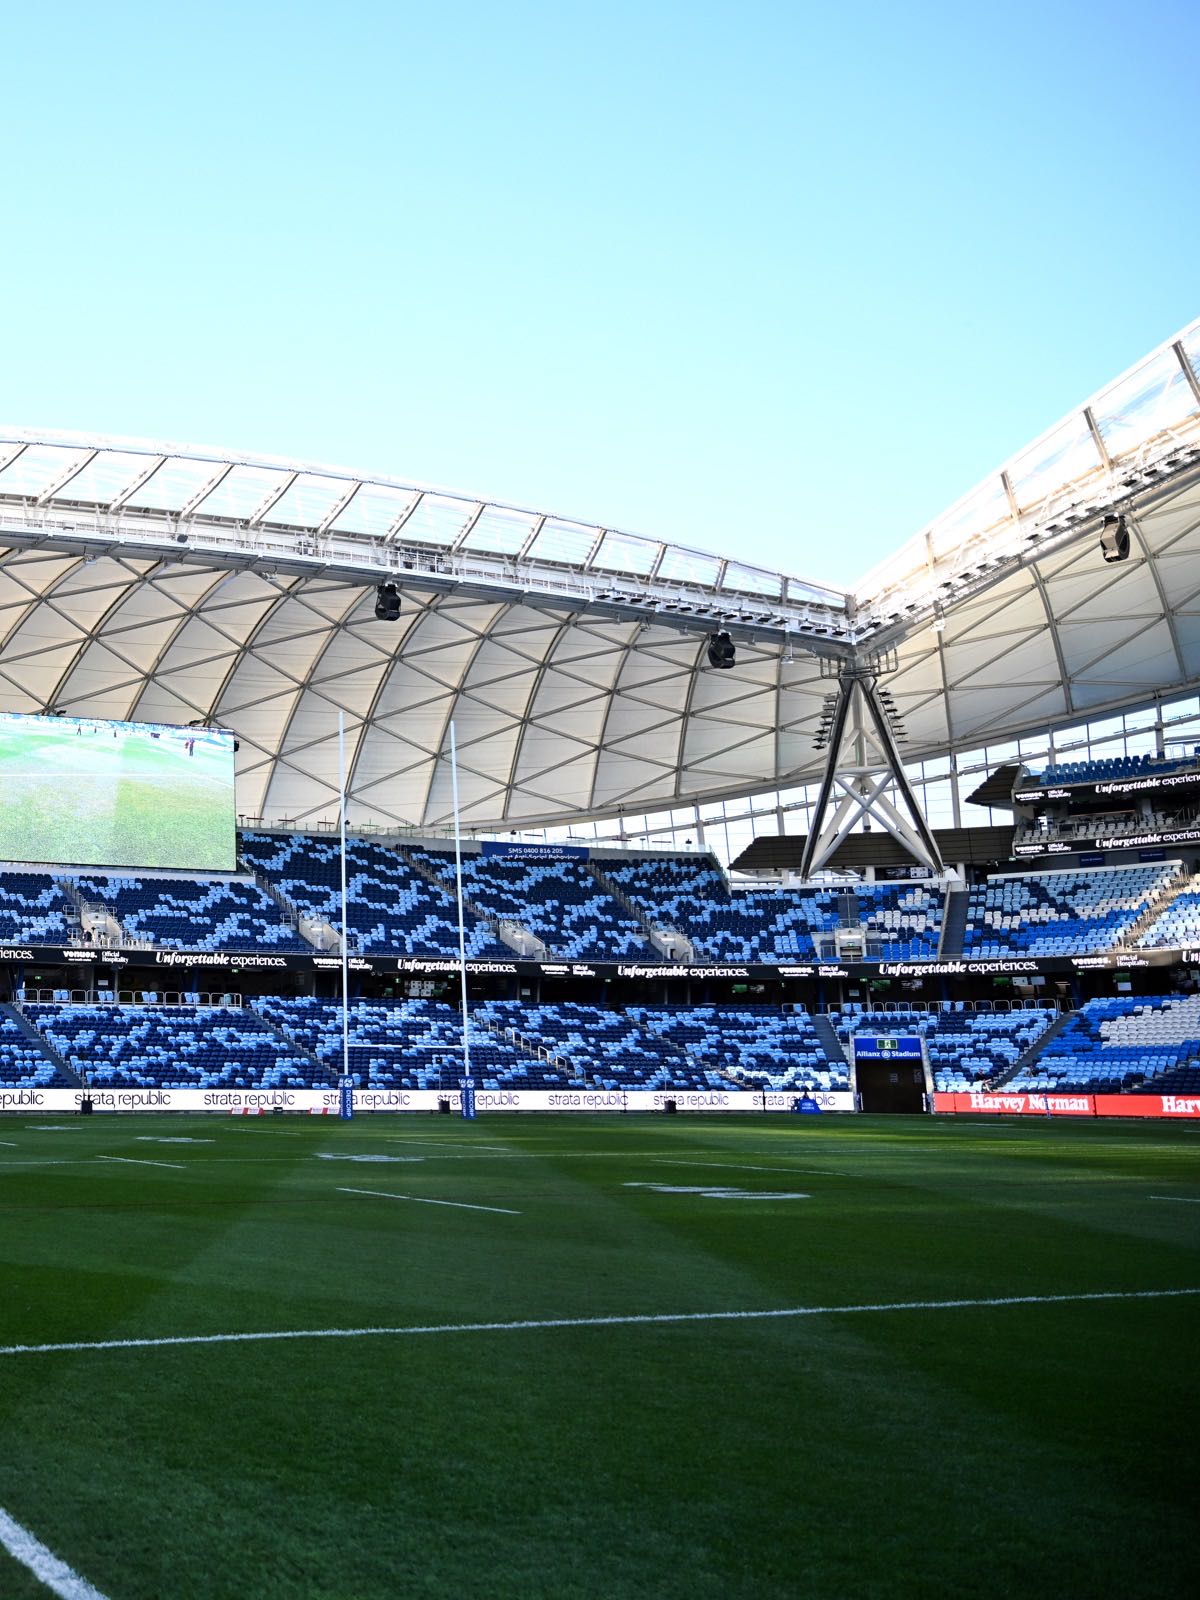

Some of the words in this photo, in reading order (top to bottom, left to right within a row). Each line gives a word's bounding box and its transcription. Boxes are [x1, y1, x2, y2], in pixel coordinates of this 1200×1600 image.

[1095, 778, 1161, 793] Unforgettable
[1095, 833, 1162, 848] Unforgettable
[63, 950, 97, 958] venues.
[156, 952, 229, 966] Unforgettable
[231, 954, 287, 967] experiences.
[1071, 956, 1111, 965] venues.
[465, 961, 517, 974] experiences.
[617, 965, 689, 979] Unforgettable
[690, 966, 749, 979] experiences.
[968, 960, 1038, 974] experiences.
[119, 1090, 171, 1109] republic
[204, 1092, 241, 1105] strata
[245, 1090, 295, 1109] republic
[362, 1091, 410, 1109] republic
[548, 1094, 581, 1105] strata
[583, 1092, 629, 1108] republic
[686, 1093, 729, 1109] republic
[970, 1094, 1026, 1112] Harvey
